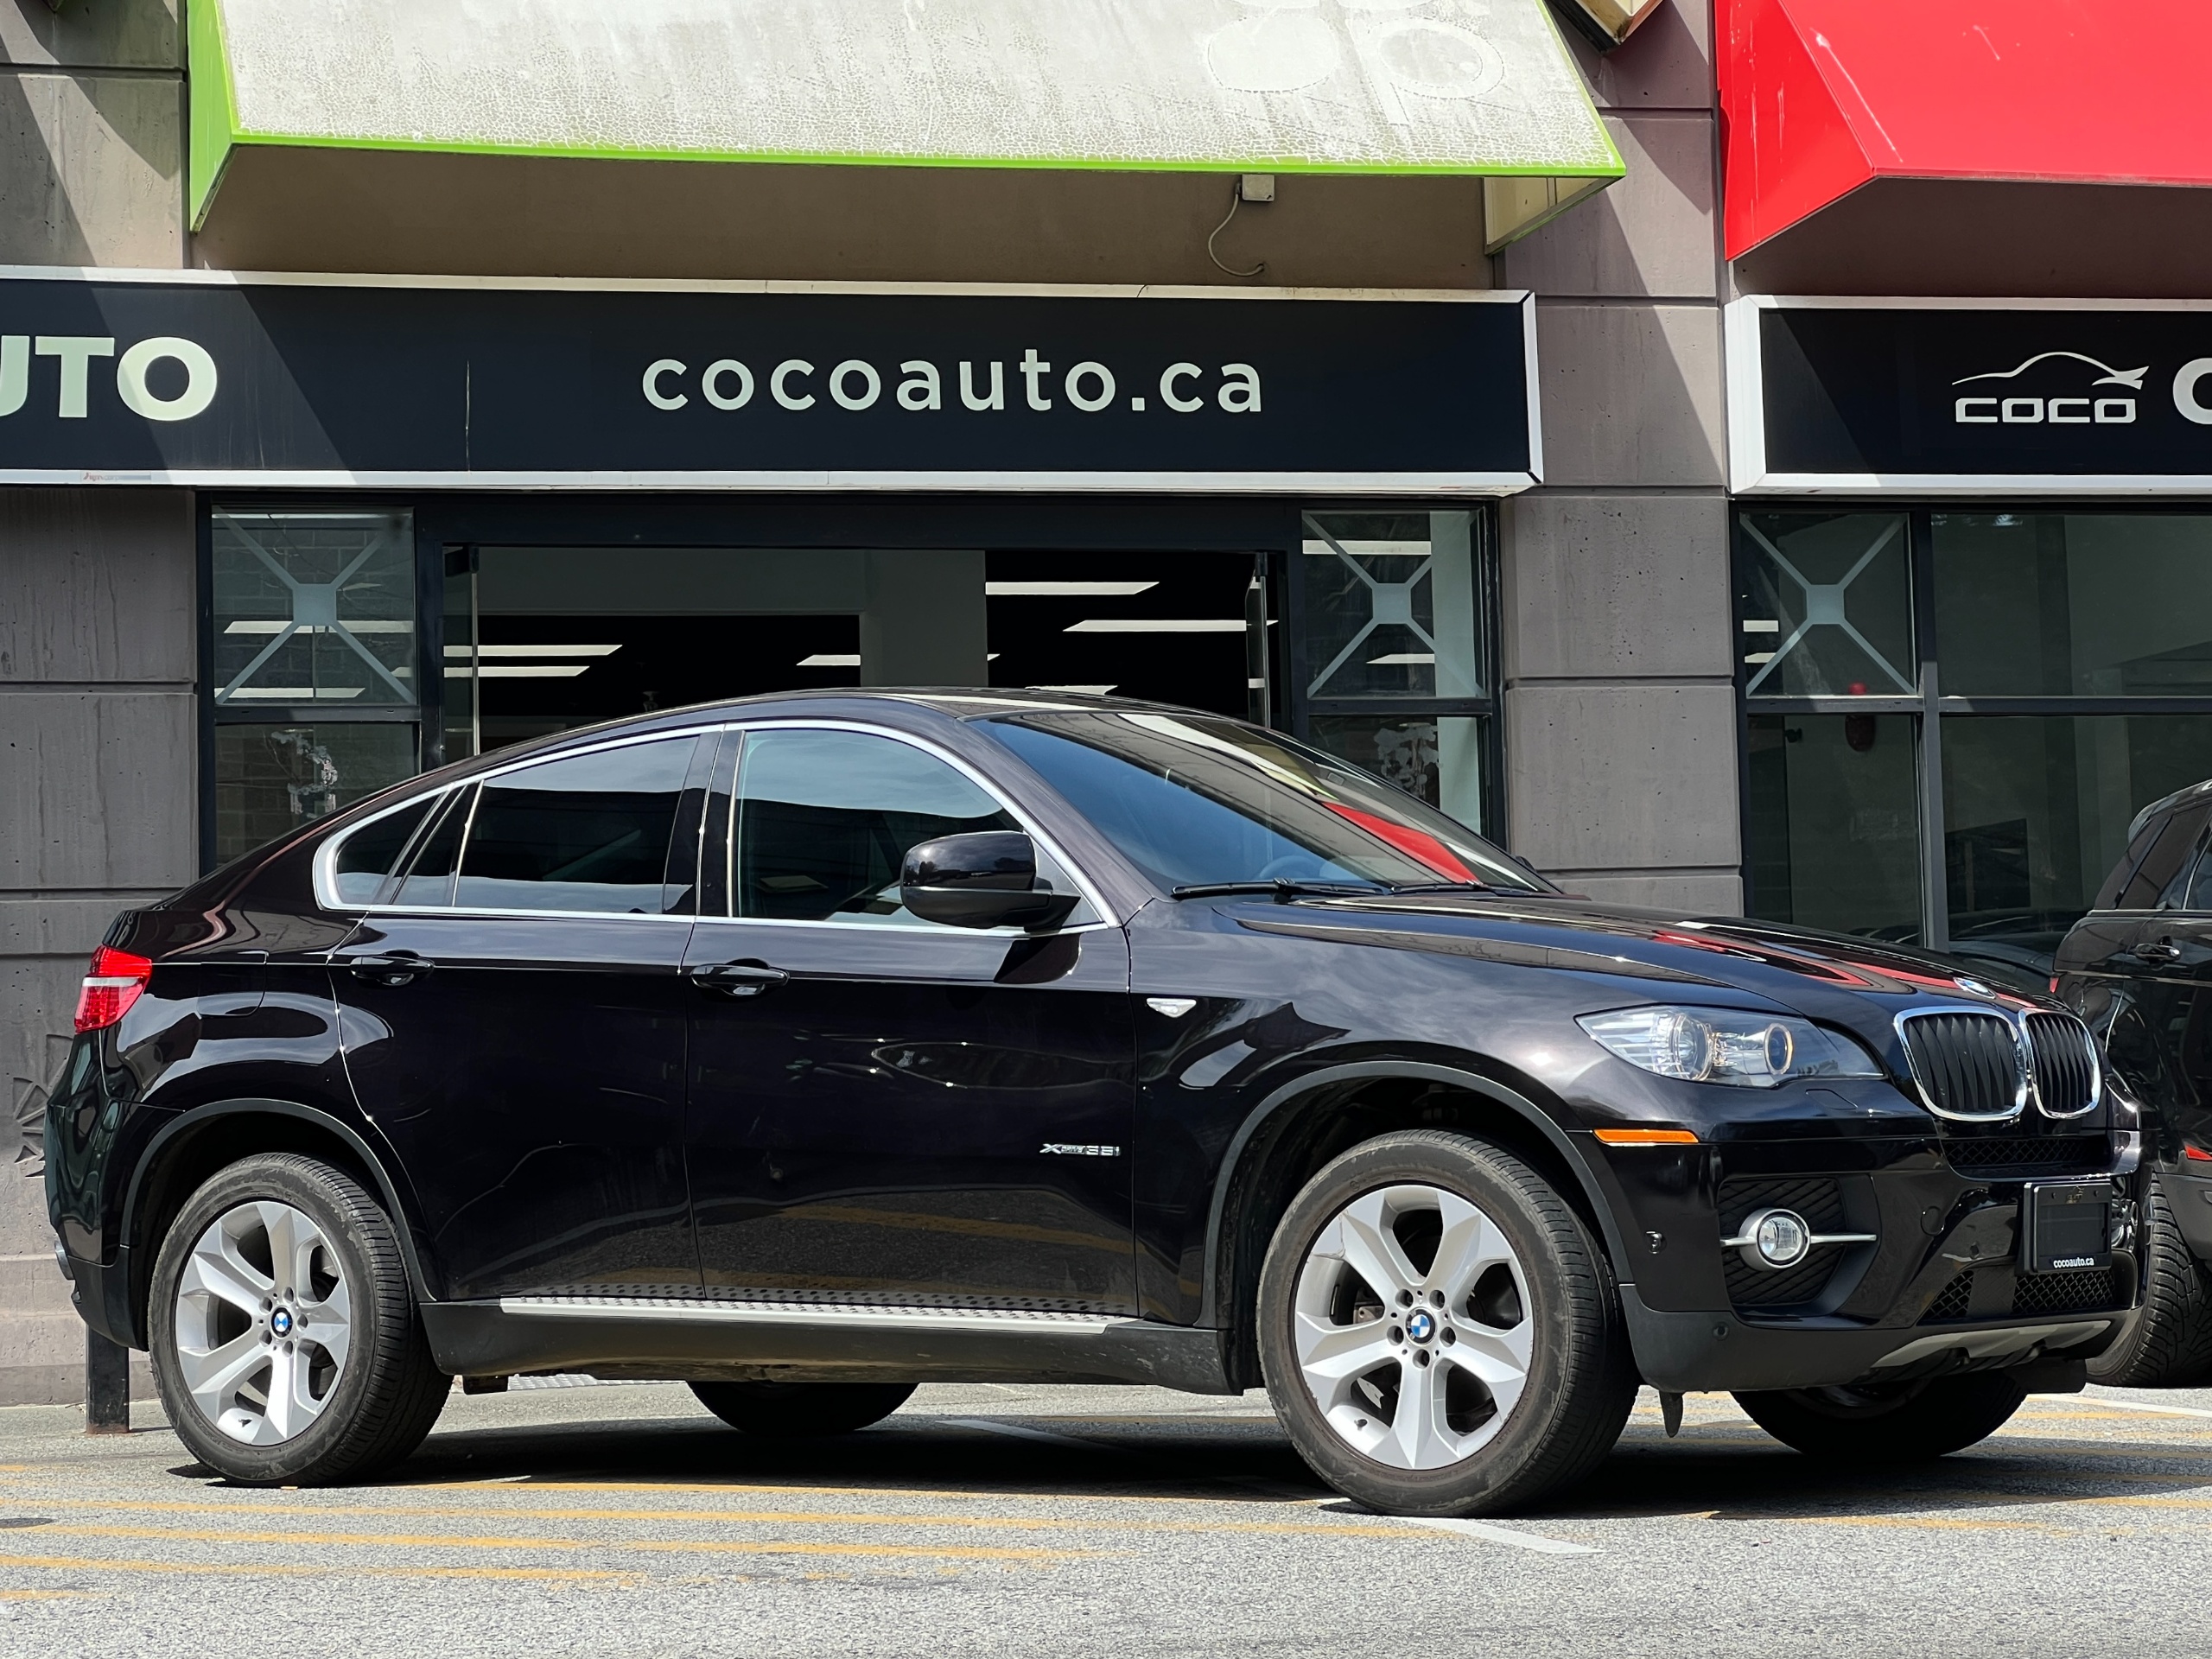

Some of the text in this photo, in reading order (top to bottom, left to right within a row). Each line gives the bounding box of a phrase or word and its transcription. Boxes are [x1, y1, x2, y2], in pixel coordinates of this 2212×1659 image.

[642, 349, 1262, 412] cocoauto.ca
[1955, 397, 2136, 423] COCO
[2053, 1257, 2094, 1268] cocoauto.ca
